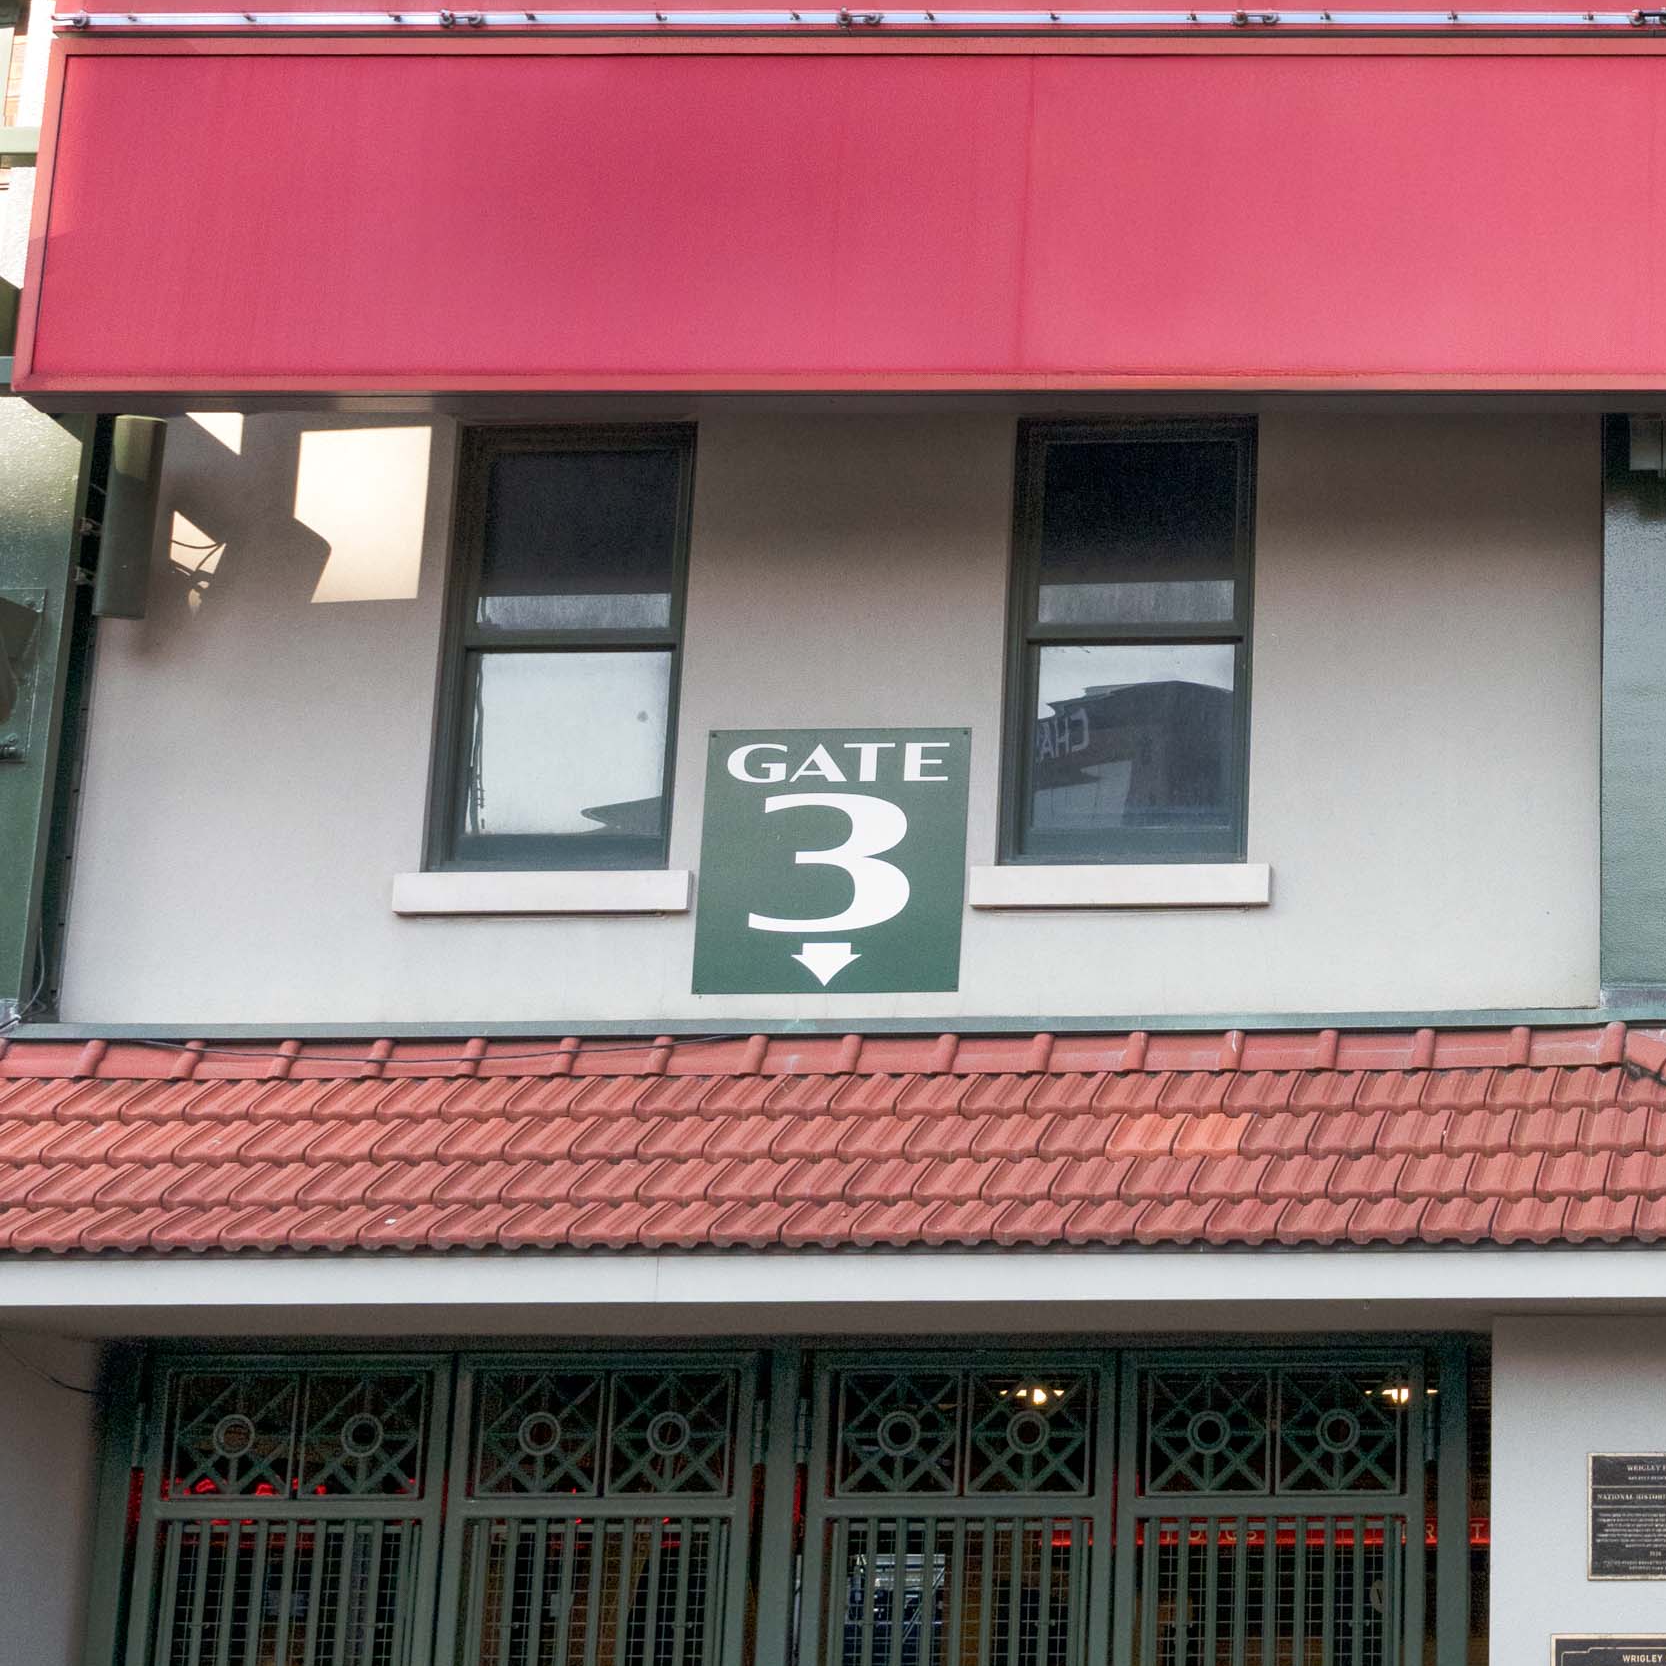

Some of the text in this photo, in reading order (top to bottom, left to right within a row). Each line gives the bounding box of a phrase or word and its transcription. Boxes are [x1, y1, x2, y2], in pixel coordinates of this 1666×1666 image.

[727, 743, 950, 784] GATE
[747, 793, 910, 933] 3
[1622, 1654, 1662, 1663] WRIGLEY
